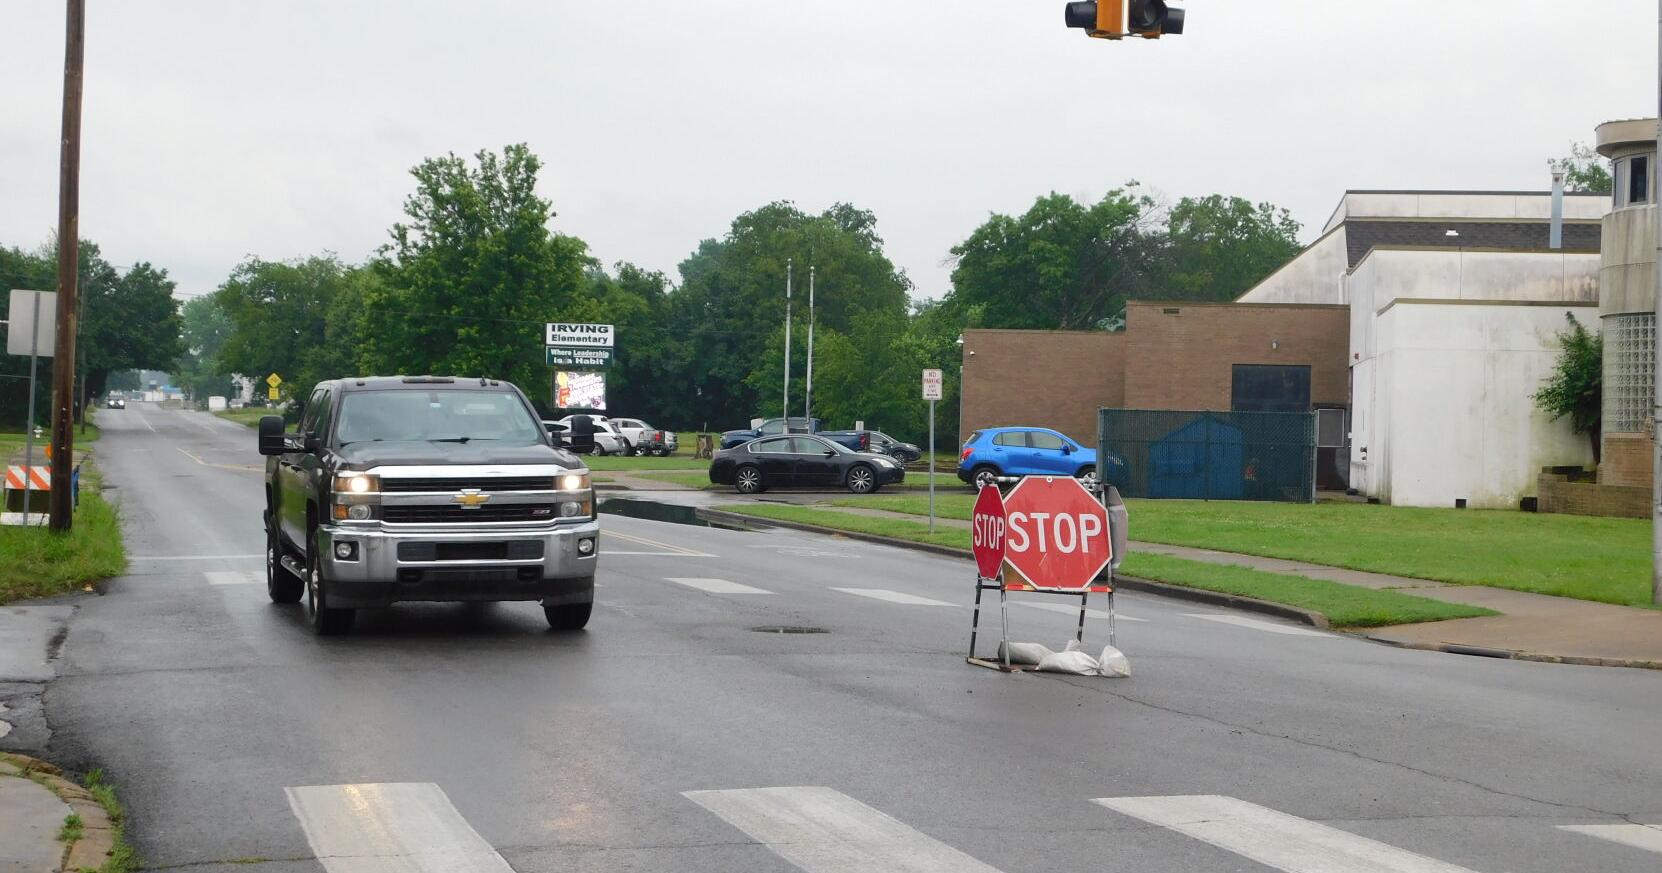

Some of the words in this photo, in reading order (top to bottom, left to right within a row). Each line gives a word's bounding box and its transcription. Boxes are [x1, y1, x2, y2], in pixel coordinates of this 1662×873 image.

[552, 324, 608, 333] IRVING
[552, 334, 608, 344] Elementary
[974, 513, 1004, 550] STOP
[1008, 512, 1102, 554] STOP
